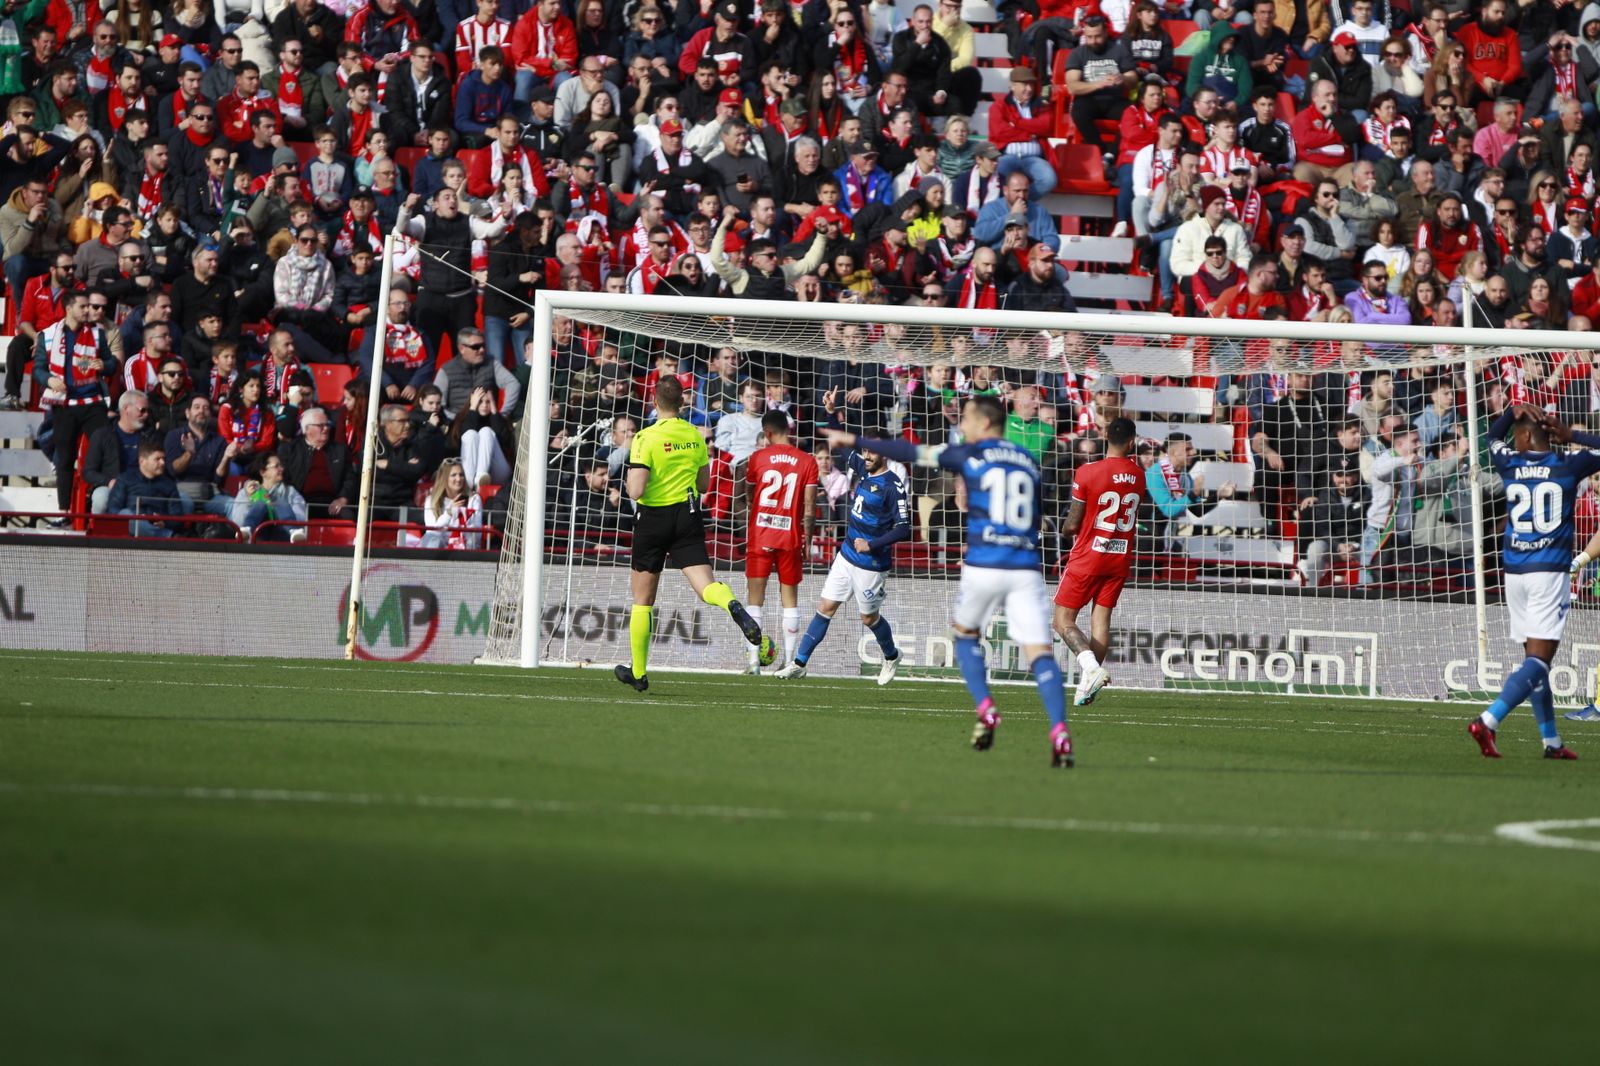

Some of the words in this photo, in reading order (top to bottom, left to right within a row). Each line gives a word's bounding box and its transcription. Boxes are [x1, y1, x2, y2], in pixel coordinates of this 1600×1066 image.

[769, 454, 798, 466] CHUMI
[1112, 473, 1137, 484] SAMU
[1515, 466, 1551, 479] ABNER
[759, 469, 799, 509] 21
[980, 467, 1034, 532] 18
[1506, 481, 1562, 534] 20
[1094, 491, 1140, 533] 23
